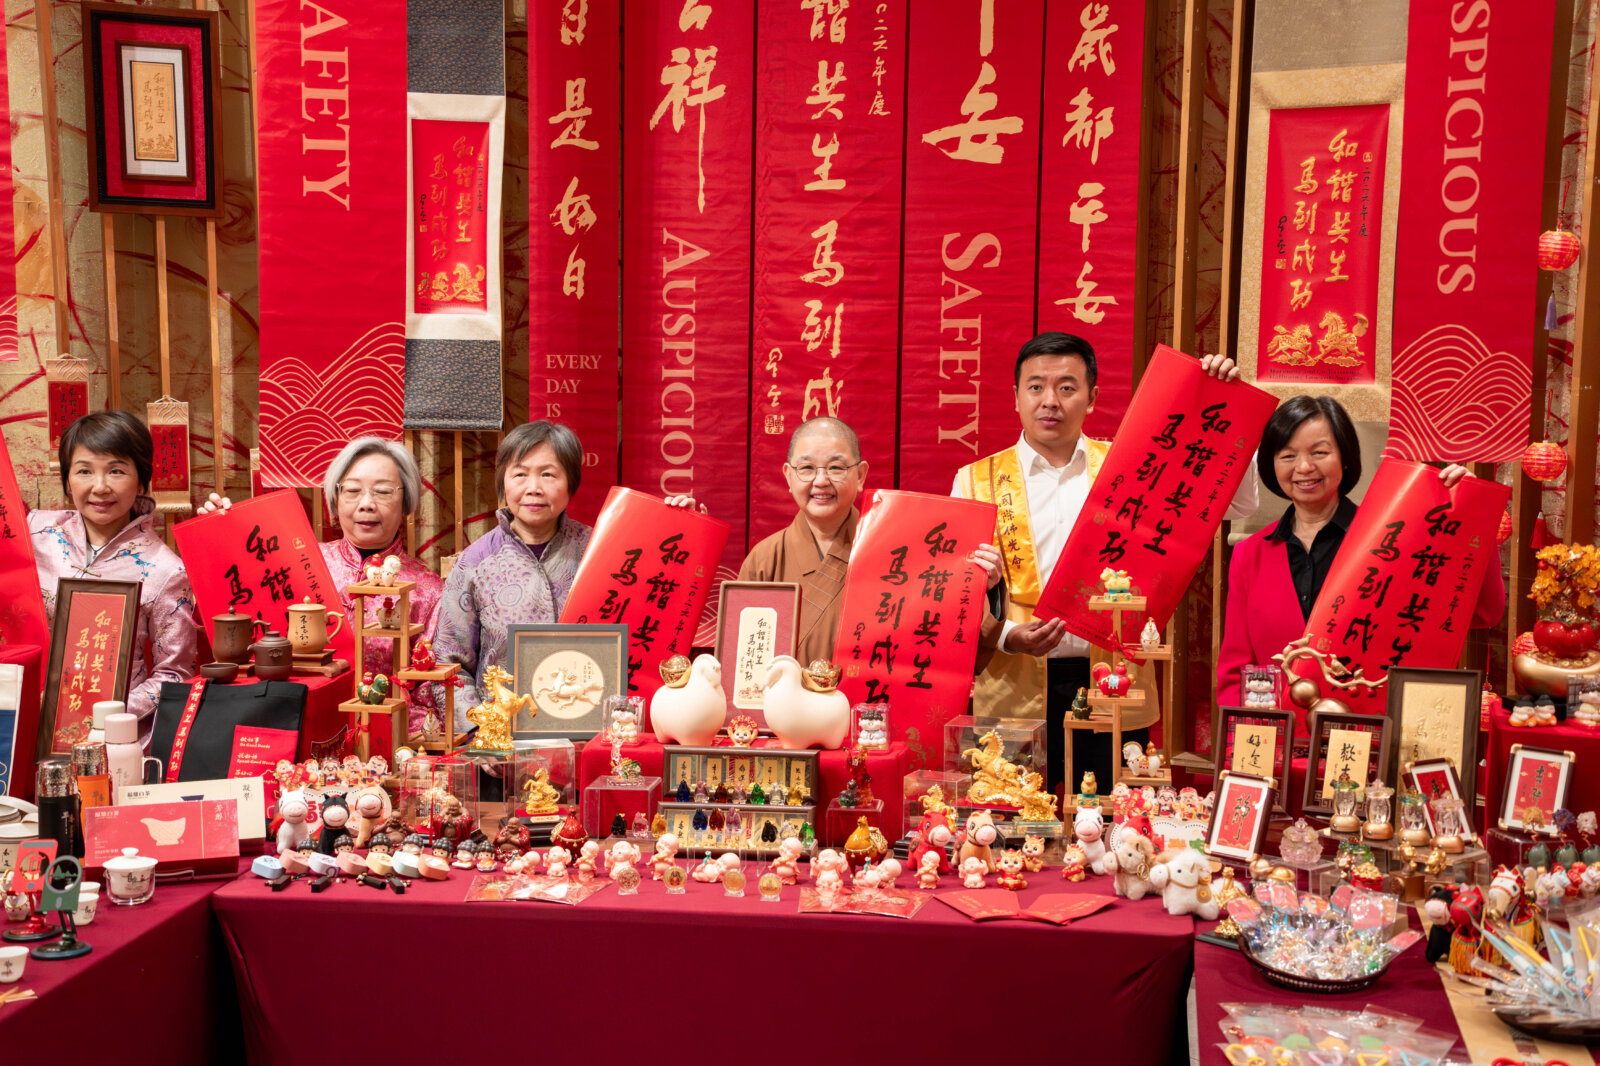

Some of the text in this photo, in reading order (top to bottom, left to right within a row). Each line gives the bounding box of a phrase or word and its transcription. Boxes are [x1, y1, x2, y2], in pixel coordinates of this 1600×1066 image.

[299, 3, 351, 211] AFETY
[1436, 0, 1490, 295] SPICIOUS
[429, 153, 448, 262] 馬到成功
[453, 136, 474, 242] 和諧共生
[1290, 156, 1318, 312] 馬到成功
[1324, 129, 1358, 282] 和諧共生
[545, 354, 602, 370] EVERY
[545, 378, 581, 394] DAY
[545, 402, 561, 418] IS
[937, 232, 1002, 455] SAFETY
[1099, 413, 1185, 564] 馬到成功
[1143, 402, 1232, 556] 和諧共生
[87, 609, 112, 693] 和諧共生
[628, 533, 690, 692] 和諧共生
[864, 545, 909, 704] 馬到成功
[906, 522, 957, 689] 和諧共生
[1380, 502, 1462, 670] 和諧共生
[69, 627, 90, 713] 馬到成功
